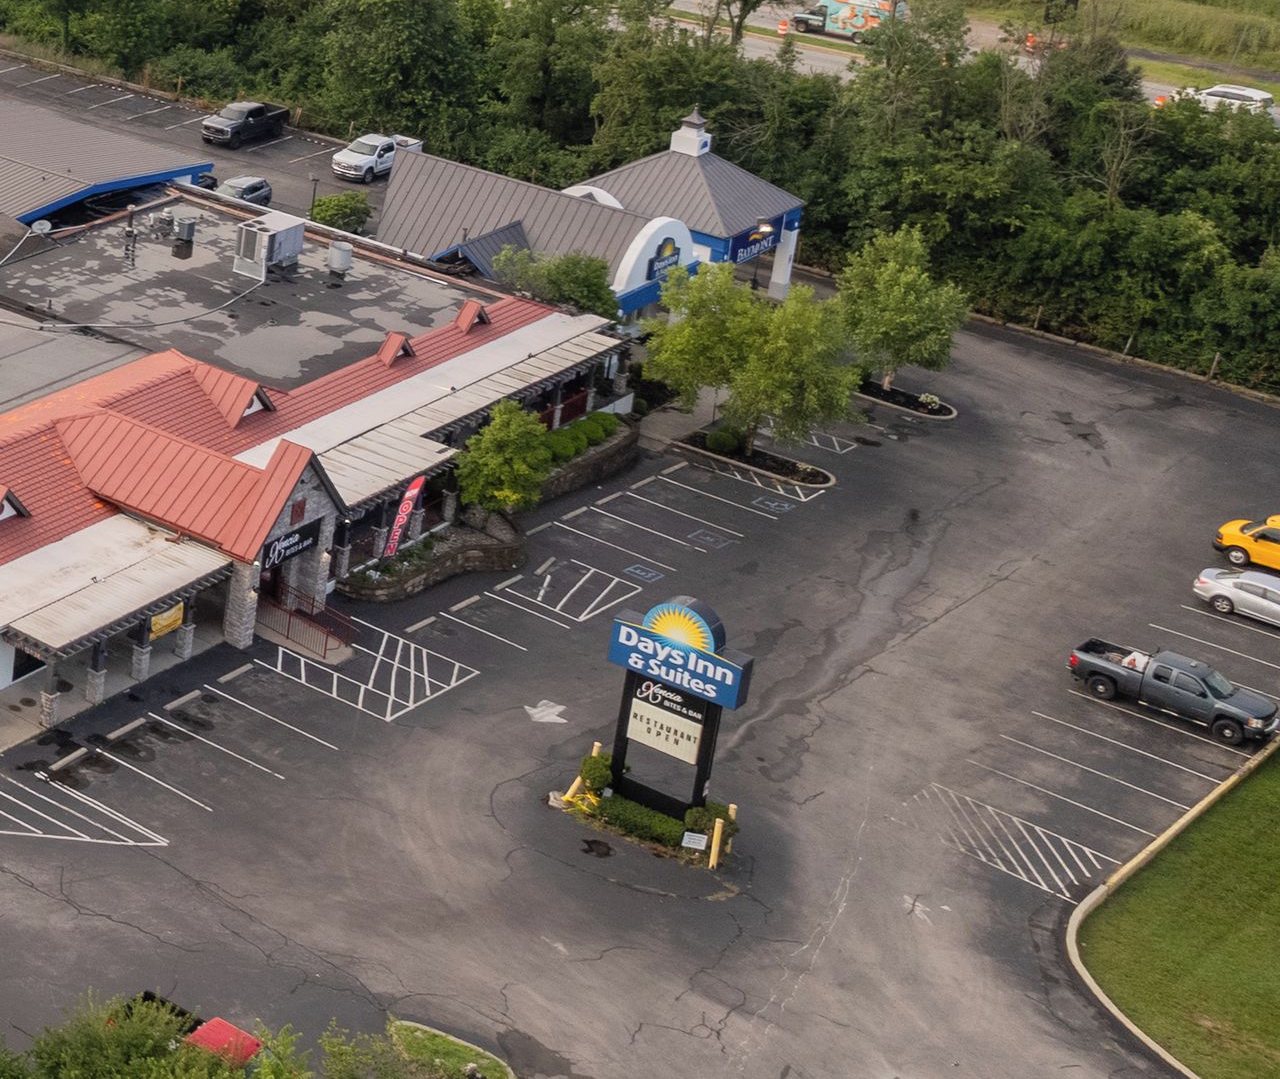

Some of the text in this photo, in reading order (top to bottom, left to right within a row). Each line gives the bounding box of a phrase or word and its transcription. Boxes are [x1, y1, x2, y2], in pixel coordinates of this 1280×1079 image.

[384, 500, 413, 557] OPEN
[618, 625, 734, 686] Days Inn
[627, 652, 717, 698] & Suites
[632, 712, 698, 744] RESTAURANT
[663, 699, 682, 712] BITES
[688, 709, 702, 720] BAR
[646, 727, 680, 746] OPEN
